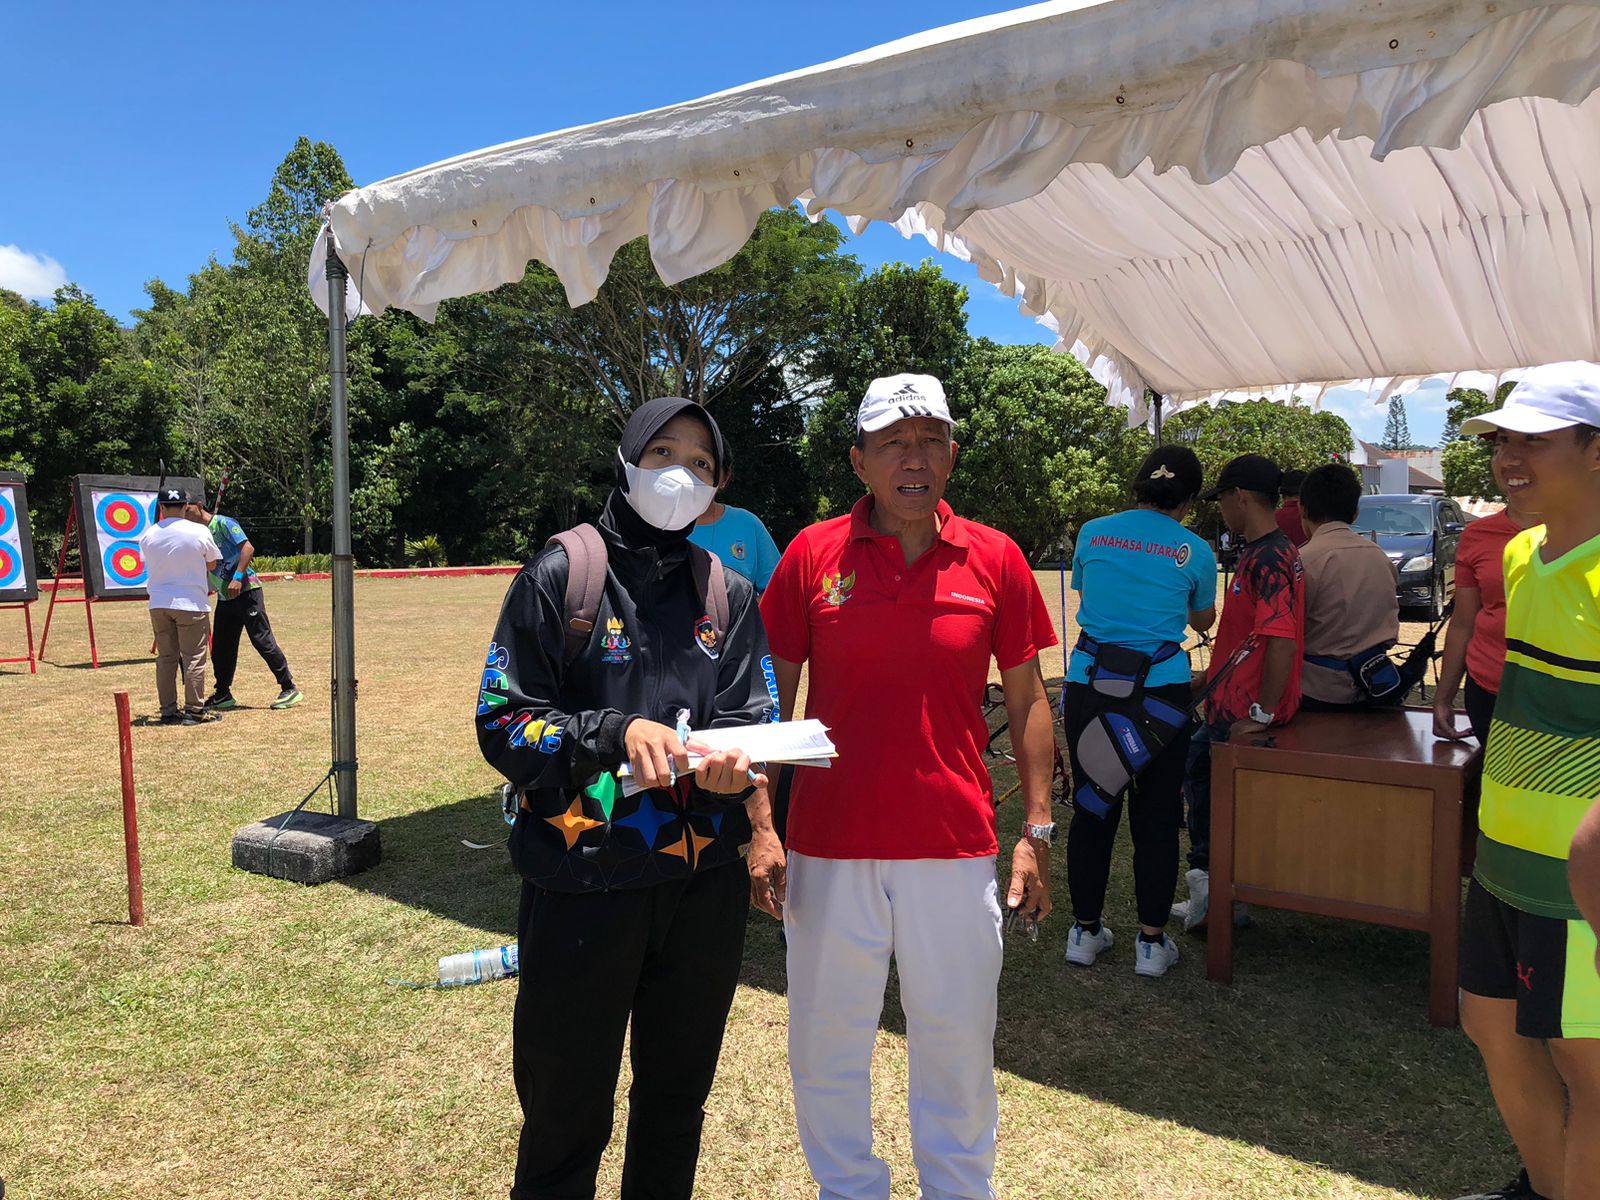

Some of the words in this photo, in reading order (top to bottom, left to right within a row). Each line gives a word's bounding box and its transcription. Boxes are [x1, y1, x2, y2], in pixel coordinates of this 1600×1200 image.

[888, 394, 927, 405] adidas
[1090, 535, 1142, 552] MINAHASA
[1146, 542, 1178, 558] UTARA
[951, 592, 985, 604] INDONESIA
[477, 641, 510, 716] SEA
